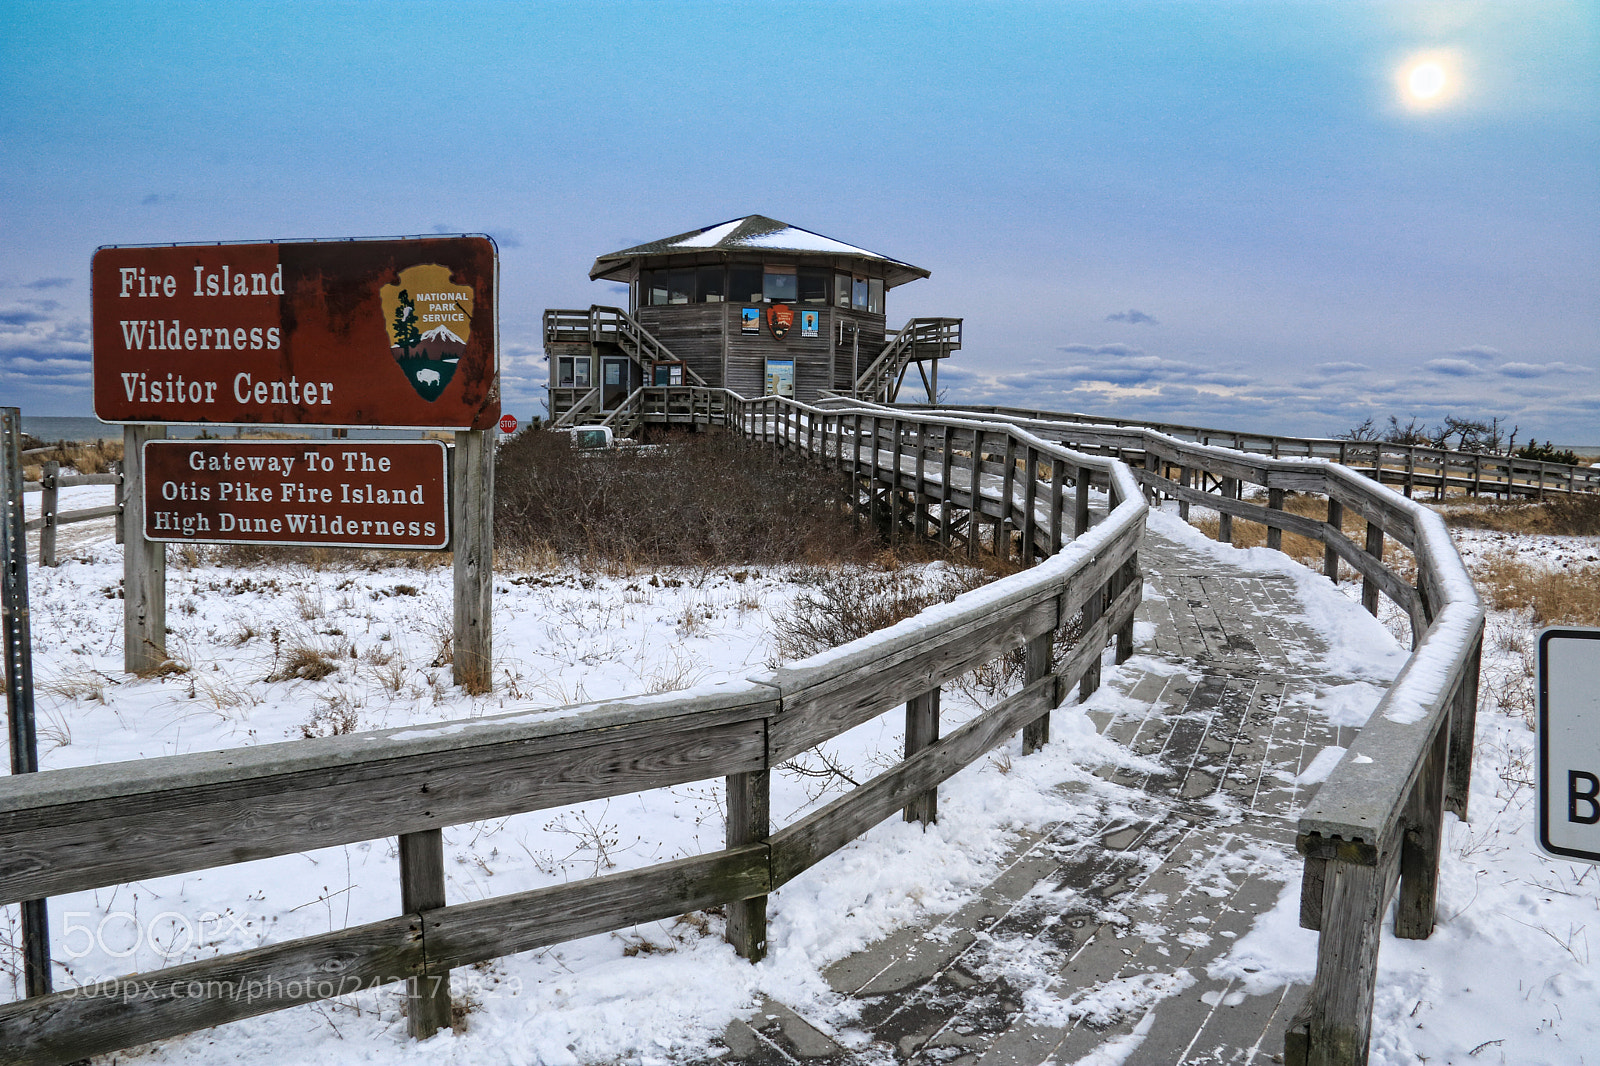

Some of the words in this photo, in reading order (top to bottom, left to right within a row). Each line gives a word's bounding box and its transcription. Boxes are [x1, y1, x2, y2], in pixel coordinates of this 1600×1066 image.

[119, 267, 177, 298] Fire
[193, 263, 285, 297] Island
[416, 292, 469, 301] NATIONAL
[429, 303, 456, 312] PARK
[422, 313, 465, 323] SERVICE
[120, 320, 281, 351] Wilderness
[121, 372, 217, 404] Visitor
[233, 373, 334, 405] Center
[500, 420, 517, 428] STOP
[189, 451, 295, 477] Gateway
[304, 452, 334, 472] To
[342, 452, 391, 473] The
[162, 481, 211, 502] Otis
[219, 483, 273, 503] Pike
[280, 483, 333, 504] Fire
[340, 484, 425, 505] Island
[154, 512, 211, 536] High
[219, 514, 282, 534] Dune
[286, 514, 436, 537] Wilderness
